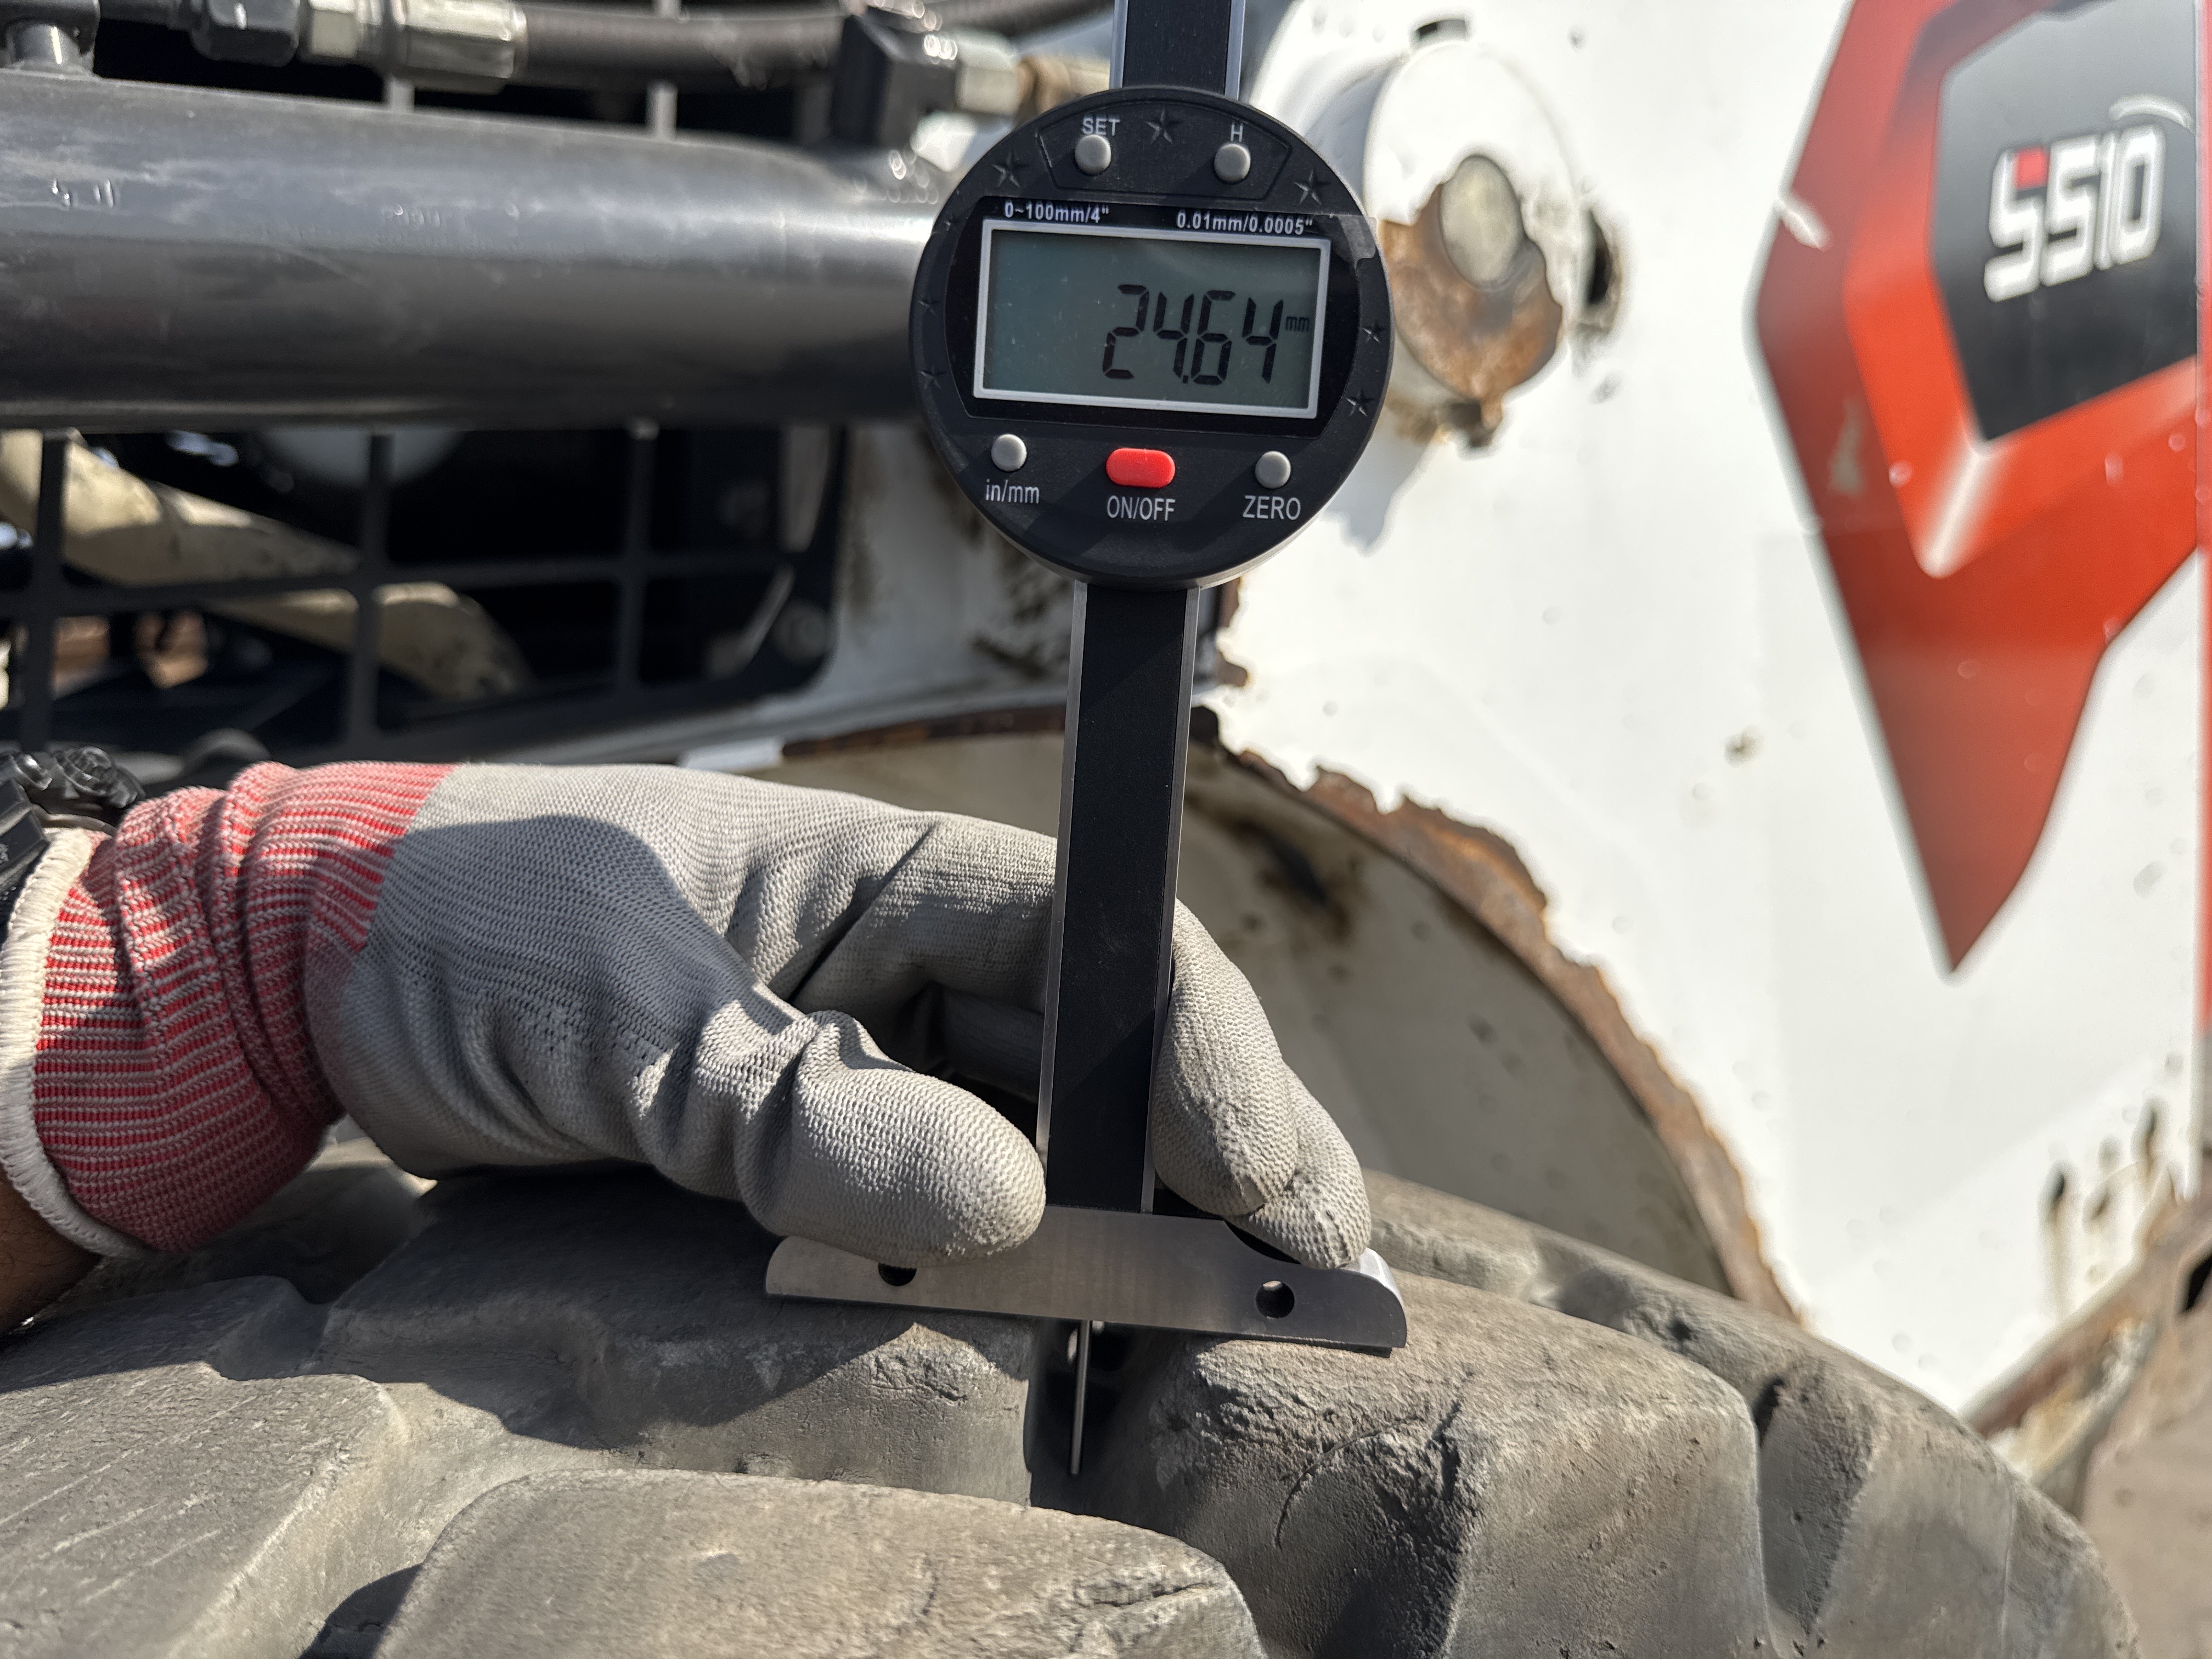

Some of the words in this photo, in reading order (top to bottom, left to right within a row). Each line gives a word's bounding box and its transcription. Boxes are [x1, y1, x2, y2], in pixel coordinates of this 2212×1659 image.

[1082, 117, 1120, 136] SET
[1230, 123, 1243, 142] H
[1177, 210, 1313, 235] 0.01mm/0.0005"
[1984, 125, 2166, 302] S510
[1103, 284, 1284, 385] 24.64
[1285, 316, 1311, 332] mm
[986, 479, 1040, 504] in/mm
[1107, 495, 1176, 521] ON/OFF
[1243, 495, 1301, 520] ZERO
